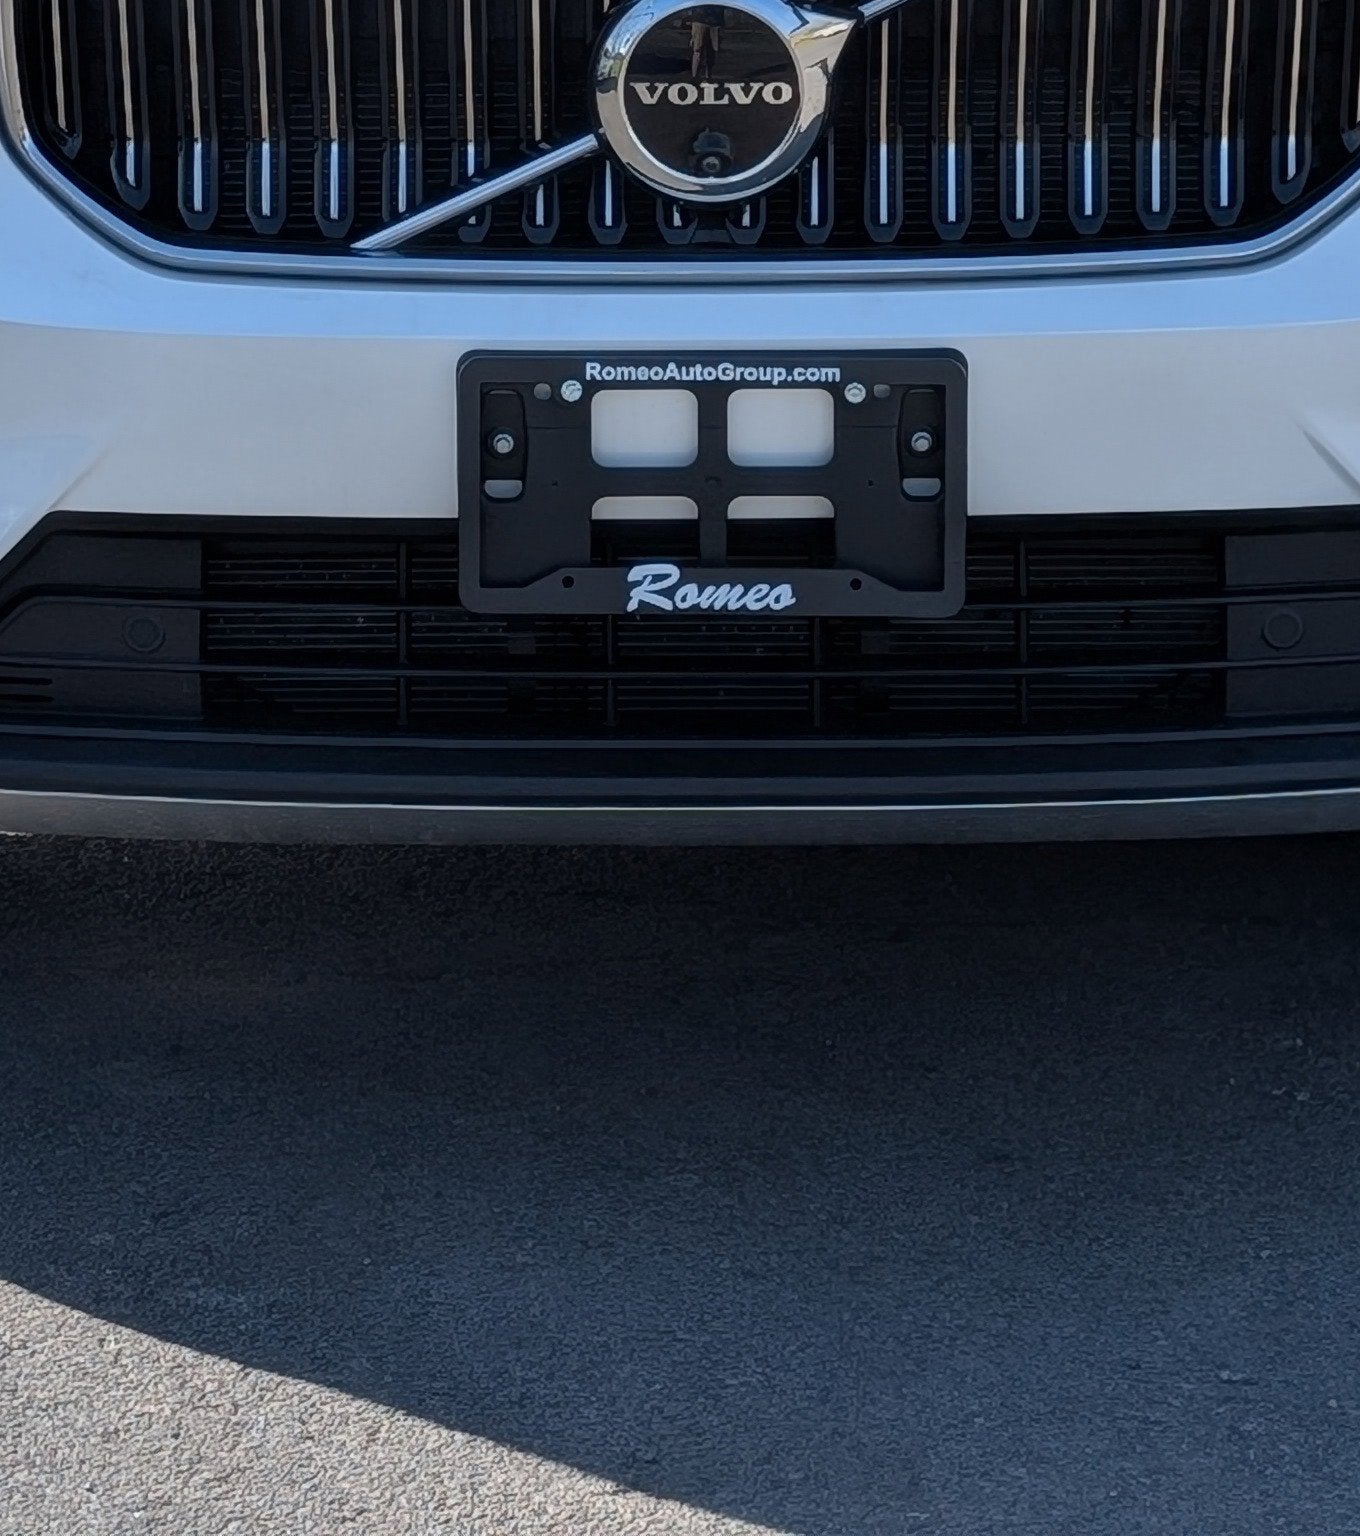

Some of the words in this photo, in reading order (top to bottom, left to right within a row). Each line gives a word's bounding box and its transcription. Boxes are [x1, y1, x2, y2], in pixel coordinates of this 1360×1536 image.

[629, 81, 793, 106] VOLVO
[585, 361, 842, 386] RomeoAutoGroup.com
[626, 563, 797, 613] Romeo
